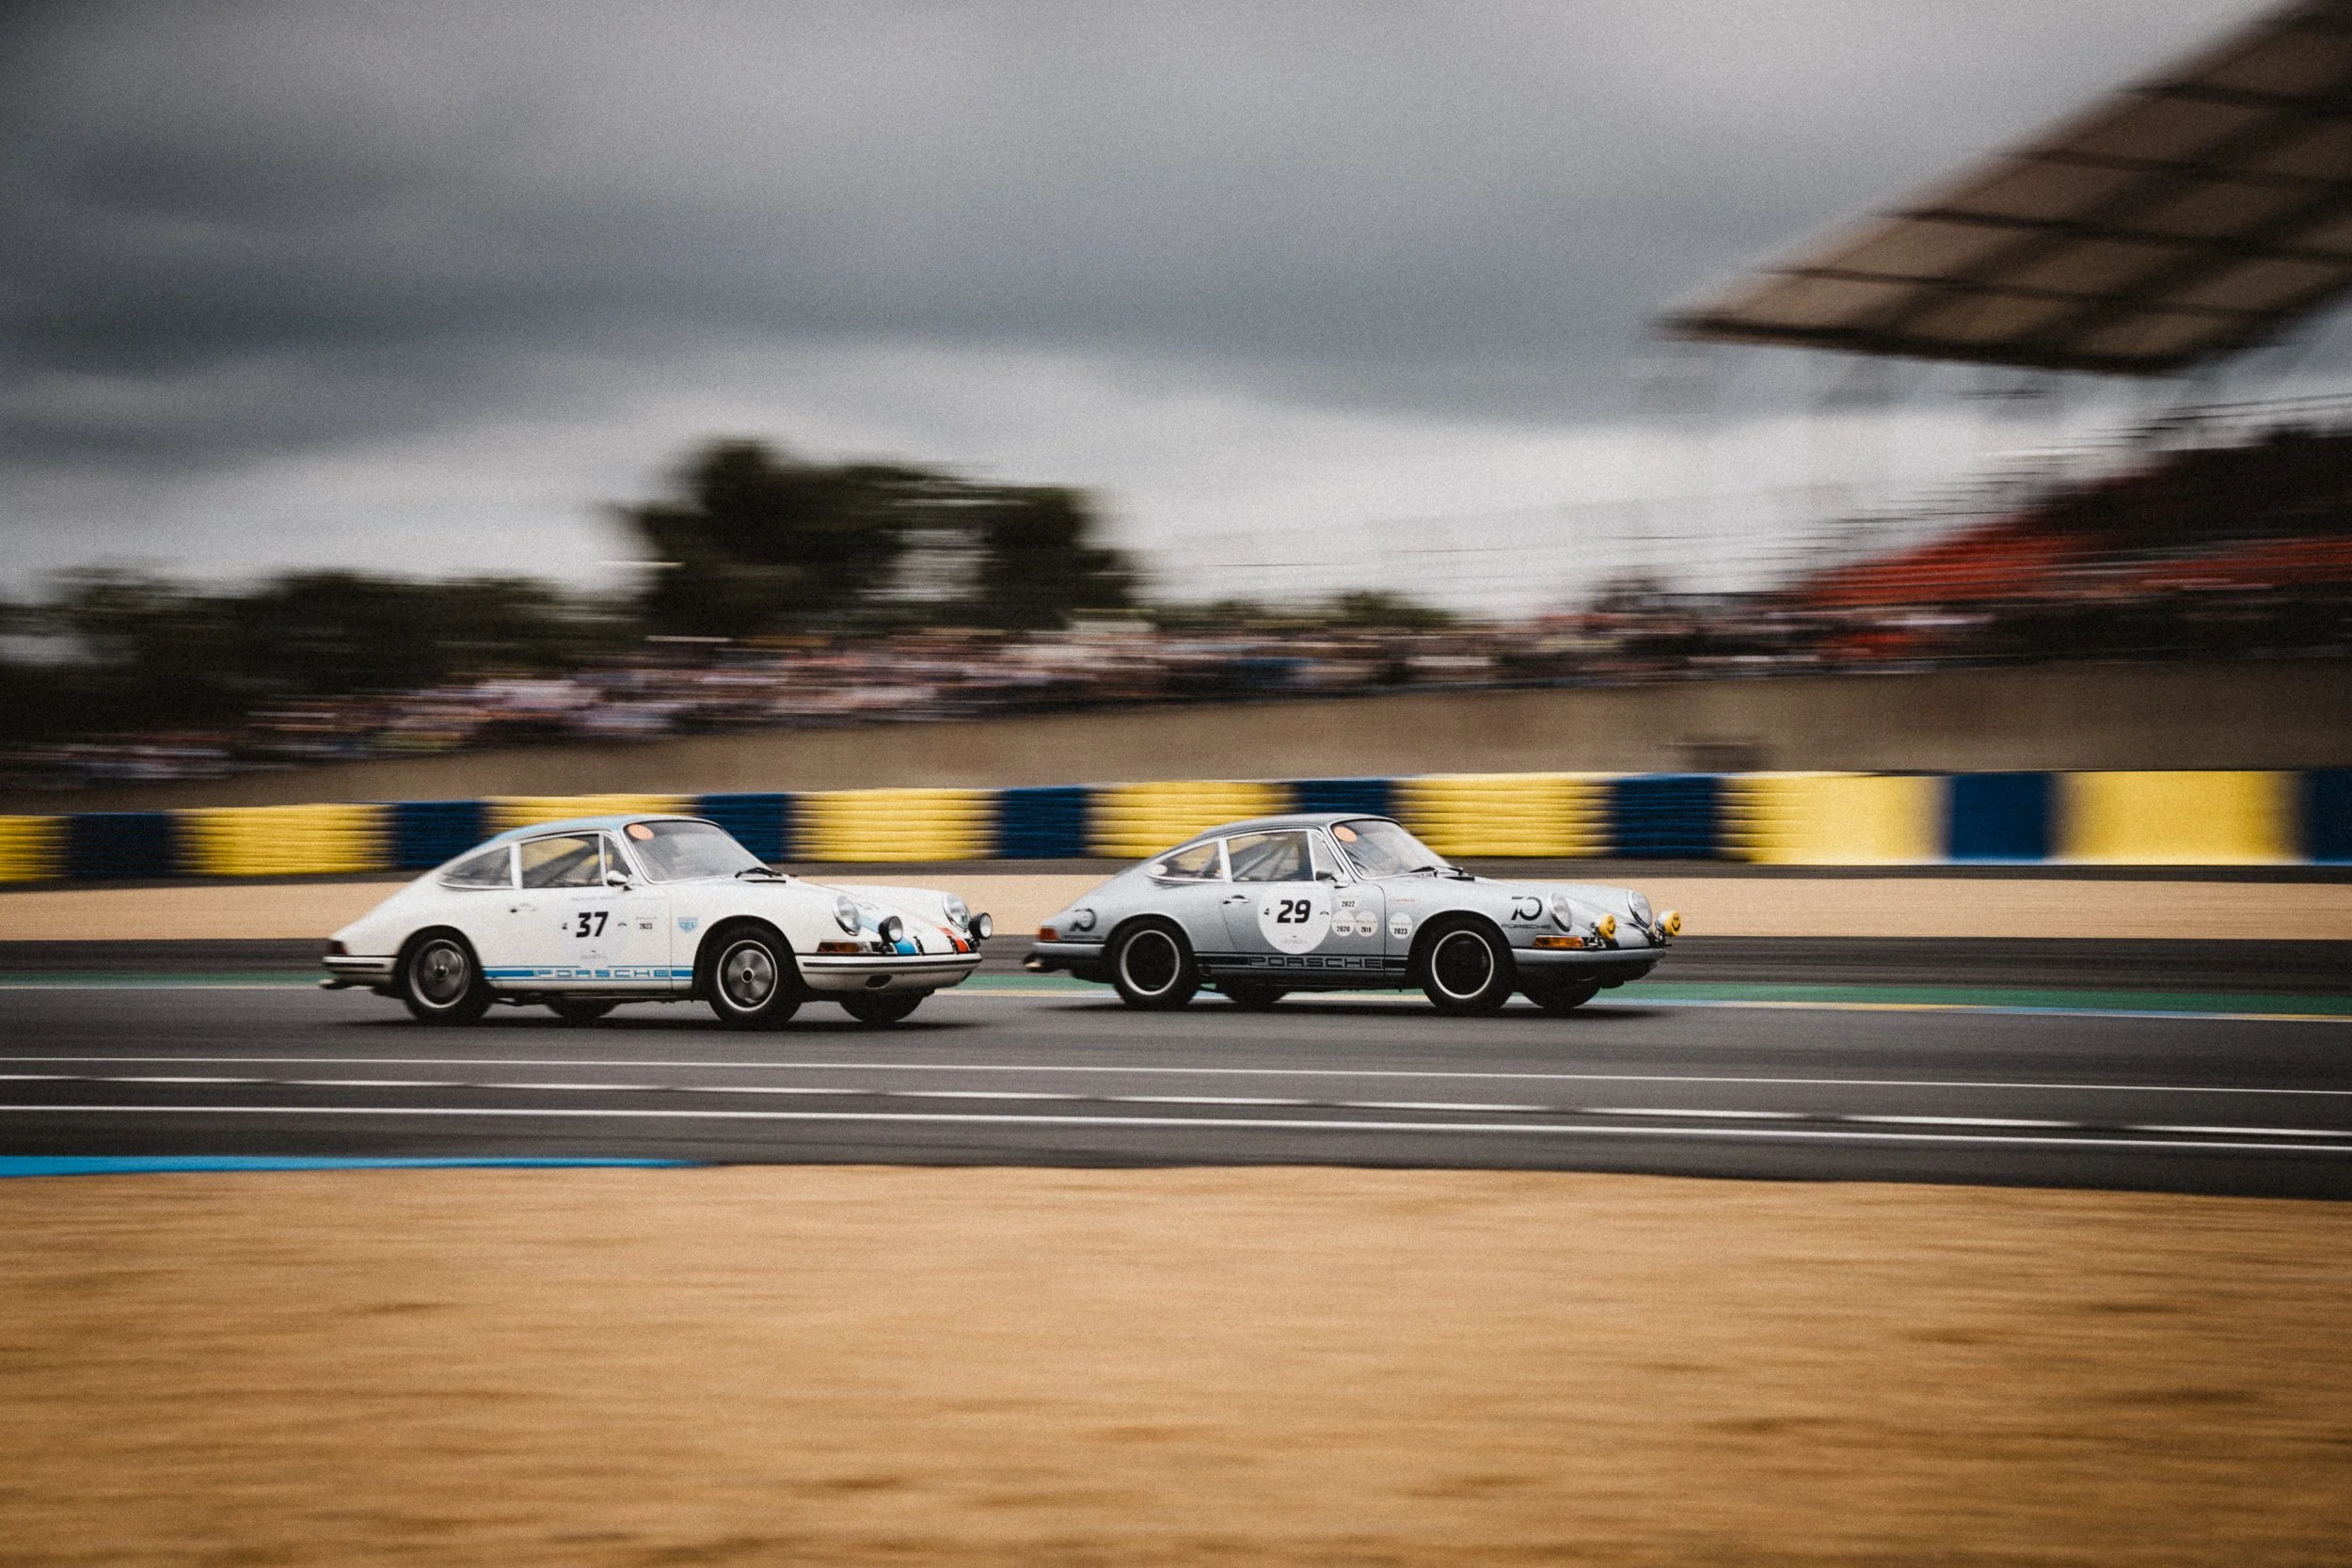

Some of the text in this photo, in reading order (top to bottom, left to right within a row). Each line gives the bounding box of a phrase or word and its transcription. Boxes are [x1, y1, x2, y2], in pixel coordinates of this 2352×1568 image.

[1277, 899, 1311, 924] 29
[576, 911, 609, 938] 37
[1248, 957, 1383, 970] PORSCHE
[535, 969, 671, 978] PORSCHE
